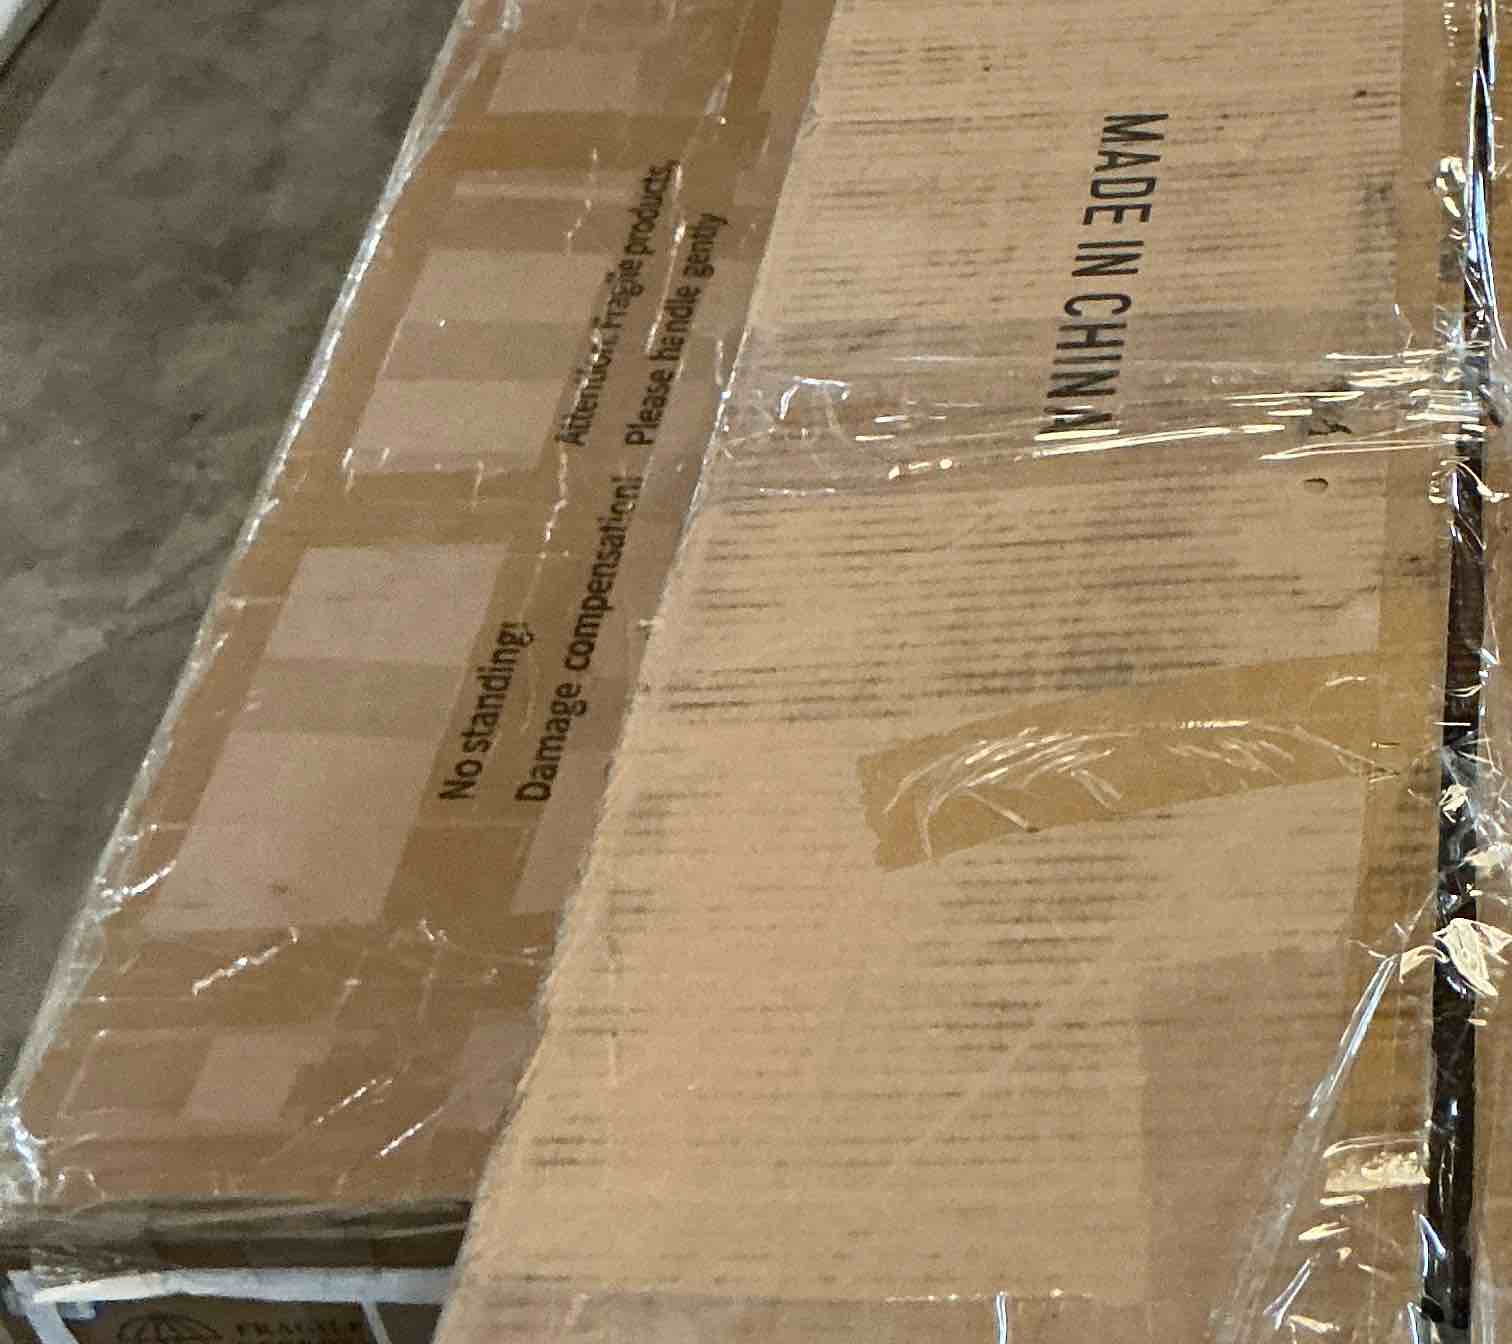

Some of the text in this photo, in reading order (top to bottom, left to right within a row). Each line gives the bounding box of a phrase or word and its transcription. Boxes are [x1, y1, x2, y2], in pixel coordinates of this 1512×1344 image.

[1083, 112, 1170, 226] MADE
[1072, 240, 1146, 278] IN
[624, 211, 729, 446] Please handle gently
[438, 758, 484, 802] No
[514, 681, 586, 804] Damage
